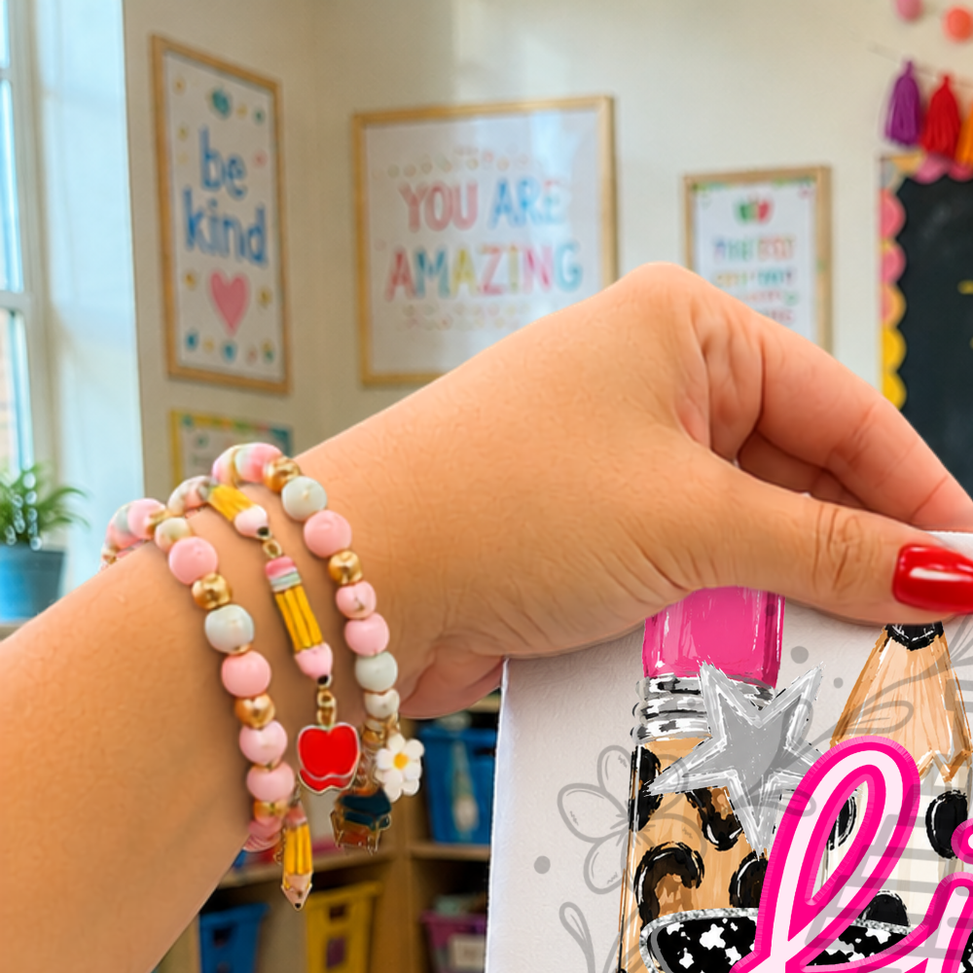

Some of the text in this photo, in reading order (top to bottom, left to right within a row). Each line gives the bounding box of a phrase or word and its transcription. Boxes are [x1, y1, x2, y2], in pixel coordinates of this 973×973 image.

[200, 124, 248, 200] be
[183, 185, 268, 268] kind
[399, 178, 565, 233] YOU ARE
[385, 242, 583, 302] AMAZING
